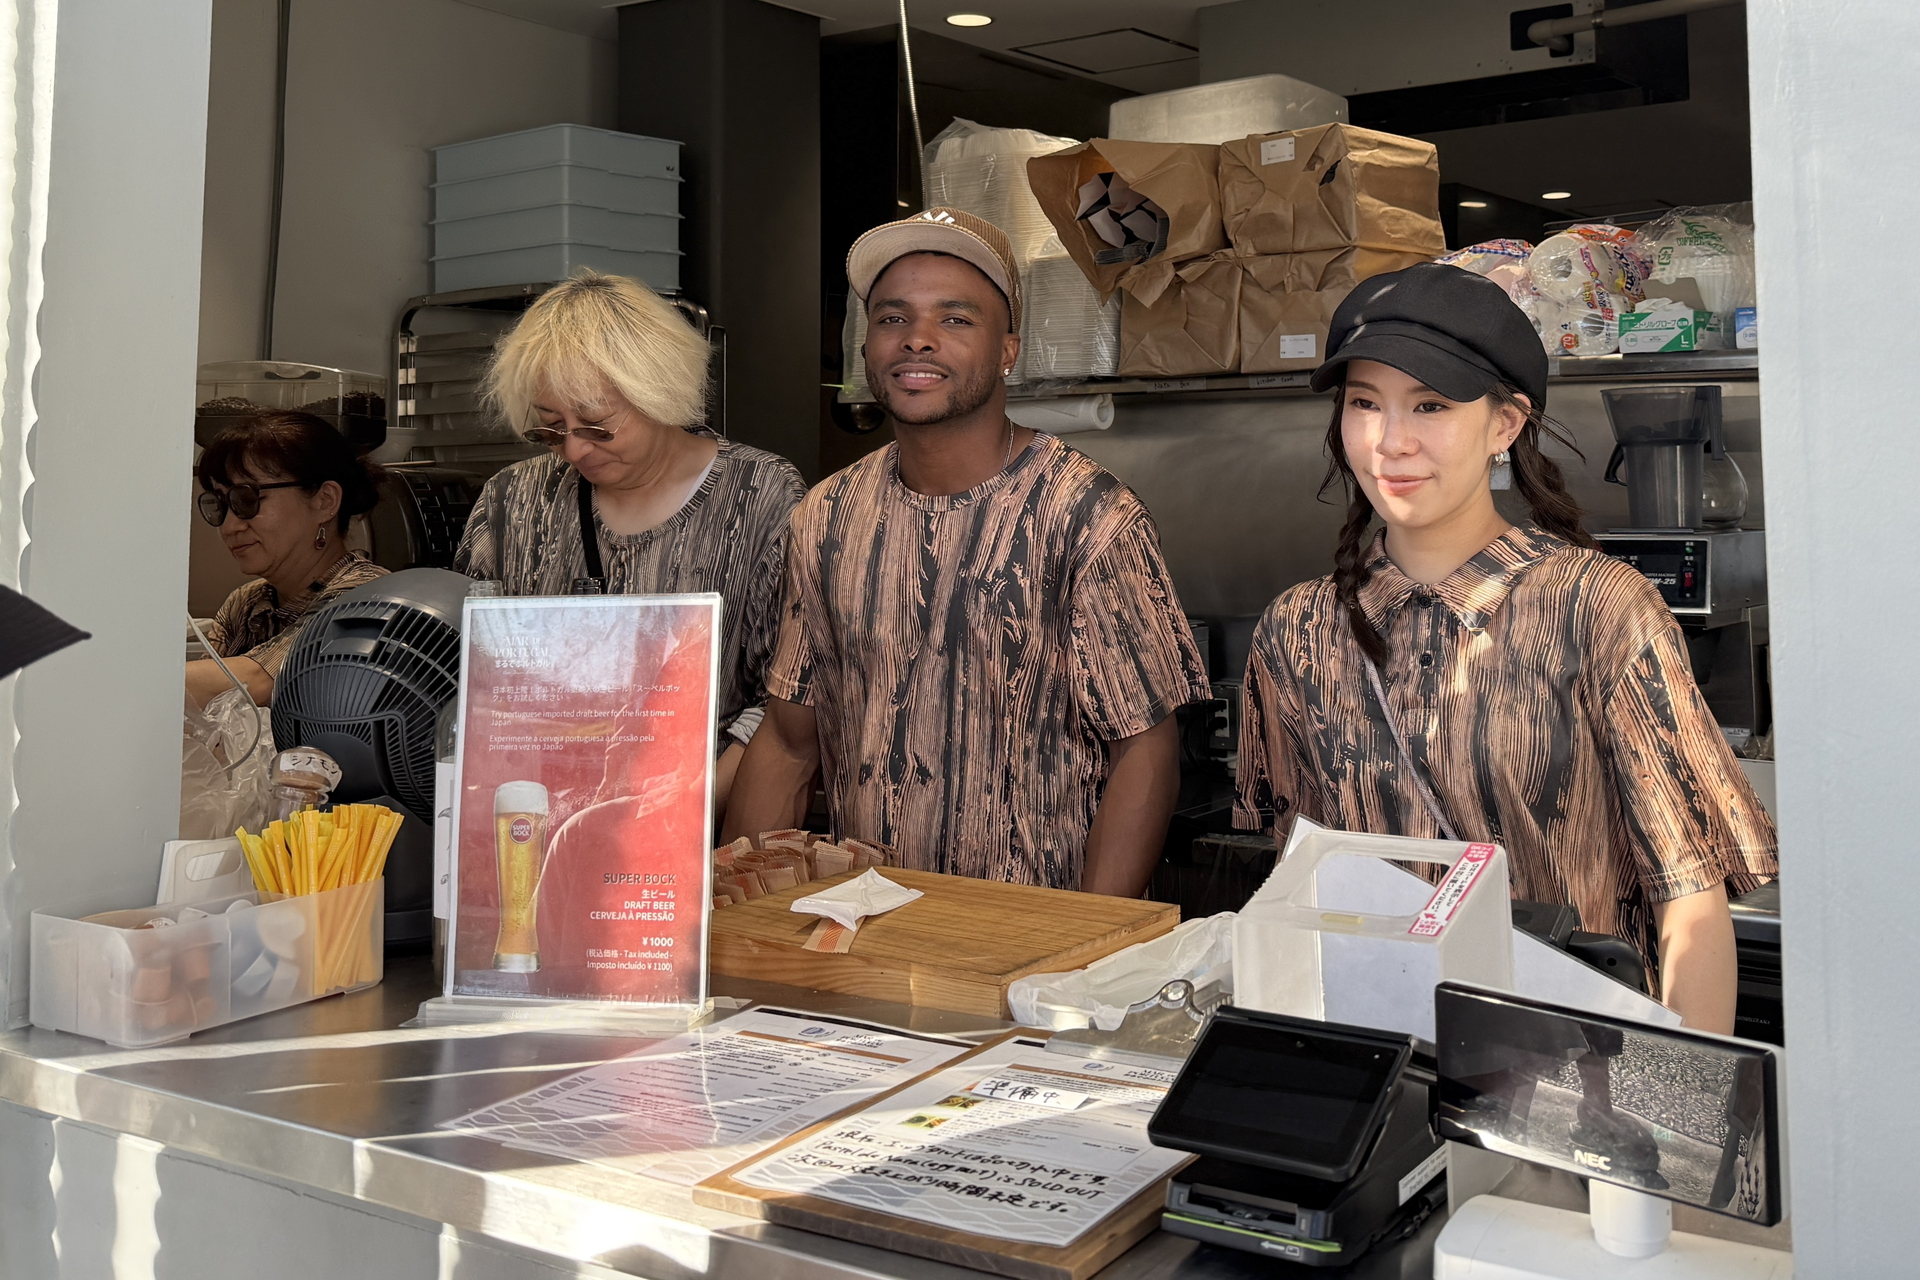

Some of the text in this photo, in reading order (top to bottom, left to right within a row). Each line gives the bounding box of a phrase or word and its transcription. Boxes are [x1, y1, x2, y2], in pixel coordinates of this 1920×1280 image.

[1680, 335, 1688, 344] L
[491, 711, 502, 720] Try
[503, 712, 541, 720] portuguese
[543, 710, 574, 719] imported
[610, 709, 621, 717] for
[489, 735, 532, 744] Experimente
[539, 736, 563, 744] cerveja
[611, 734, 638, 742] pressão
[292, 756, 338, 774] シナモン
[603, 873, 677, 885] SUPER BOCK
[641, 889, 676, 899] 生ビール
[624, 901, 675, 910] DRAFT BEER
[590, 910, 675, 921] CERVEJA À PRESSÃO
[586, 948, 618, 958] (税込価格
[624, 950, 637, 958] Tax
[638, 950, 669, 959] included
[587, 961, 616, 970] Imposto
[617, 960, 646, 970] incluído
[653, 962, 673, 972] 1100)
[1574, 1149, 1612, 1171] NEC
[997, 1176, 1014, 1184] is
[1015, 1178, 1064, 1191] SOLD
[1065, 1187, 1105, 1200] OUT
